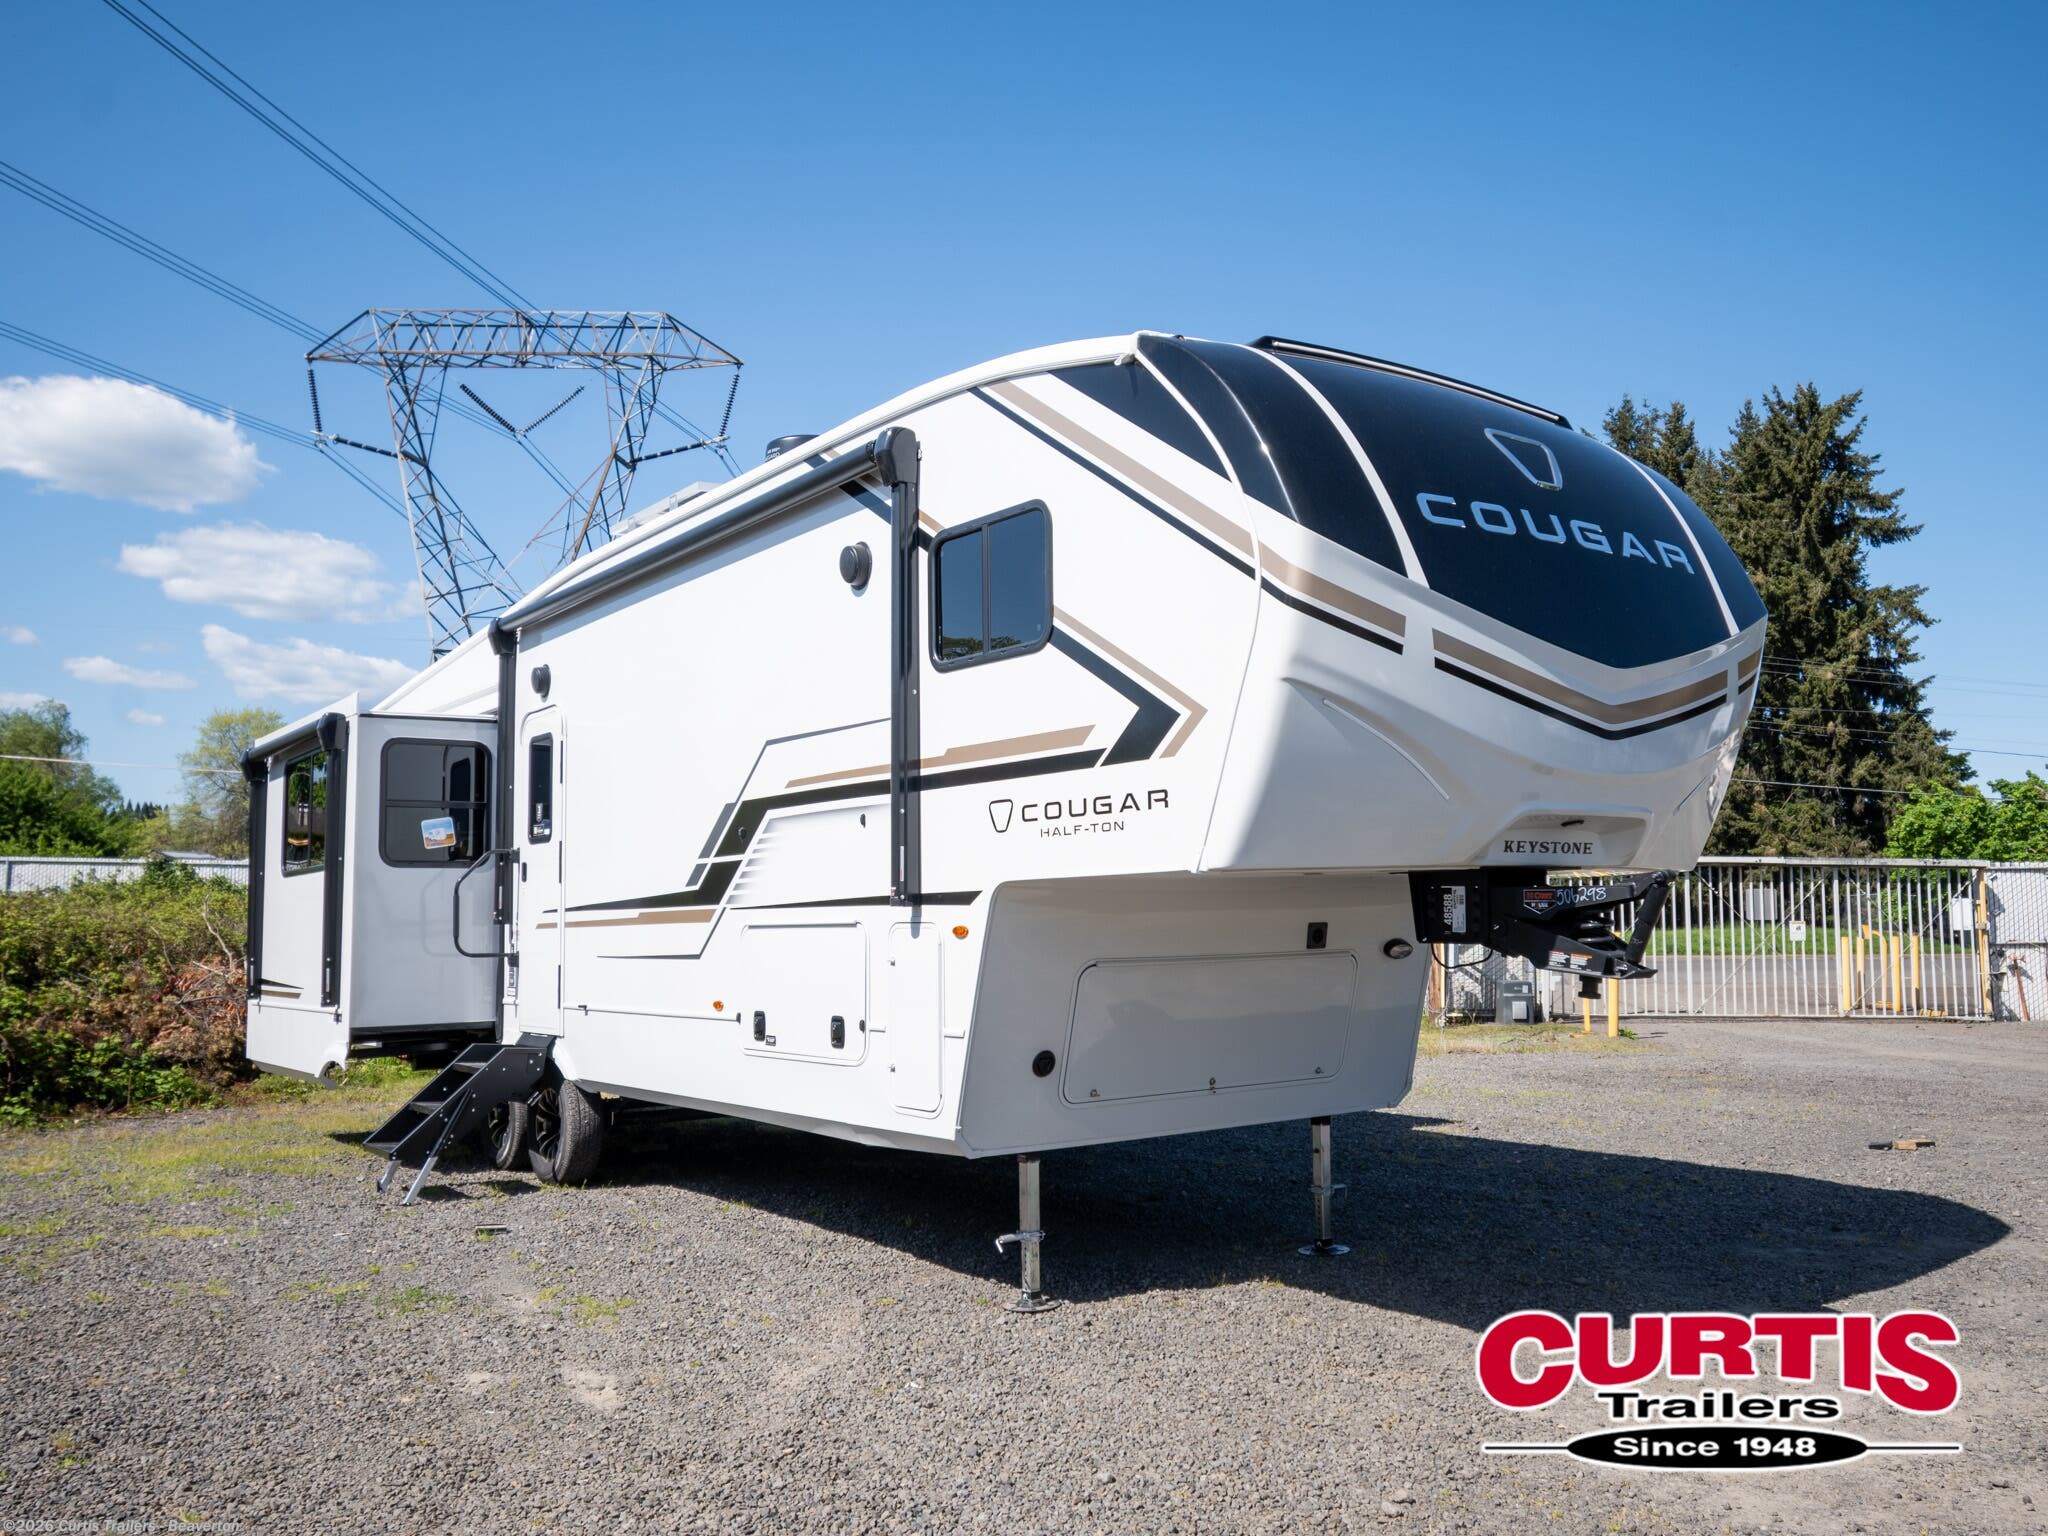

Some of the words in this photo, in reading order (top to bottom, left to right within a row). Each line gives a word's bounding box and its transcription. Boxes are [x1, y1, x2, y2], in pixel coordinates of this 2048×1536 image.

[1416, 492, 1695, 575] COUGAR
[1022, 789, 1169, 822] COUGAR
[1040, 821, 1125, 838] HALF-TON
[1504, 840, 1593, 855] KEYSTONE
[1557, 887, 1607, 906] 506298
